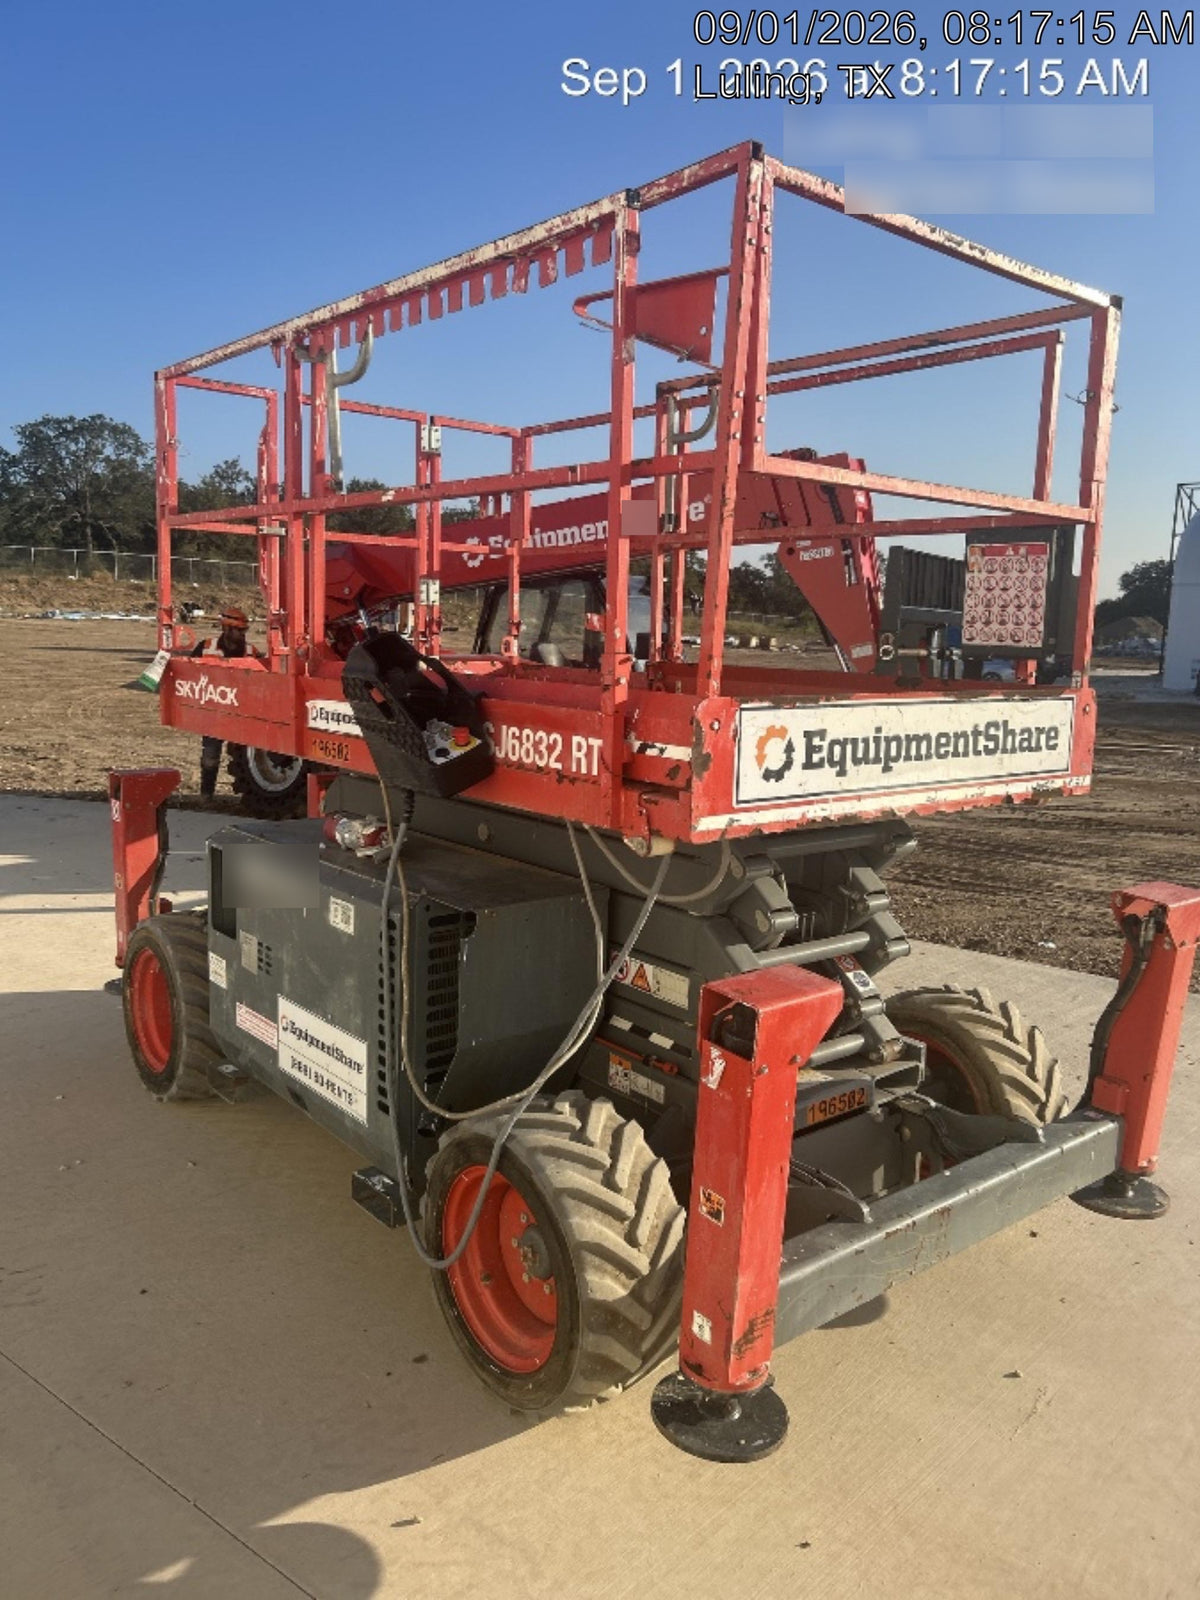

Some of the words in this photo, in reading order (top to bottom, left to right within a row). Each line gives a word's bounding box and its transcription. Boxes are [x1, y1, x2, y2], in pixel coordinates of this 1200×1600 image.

[175, 672, 239, 707] SKYJACK
[482, 721, 563, 770] SJ6832
[571, 735, 603, 776] RT
[801, 719, 1060, 777] EquipmentShare
[289, 1020, 365, 1075] EquipmentShare
[808, 1087, 865, 1123] 196502
